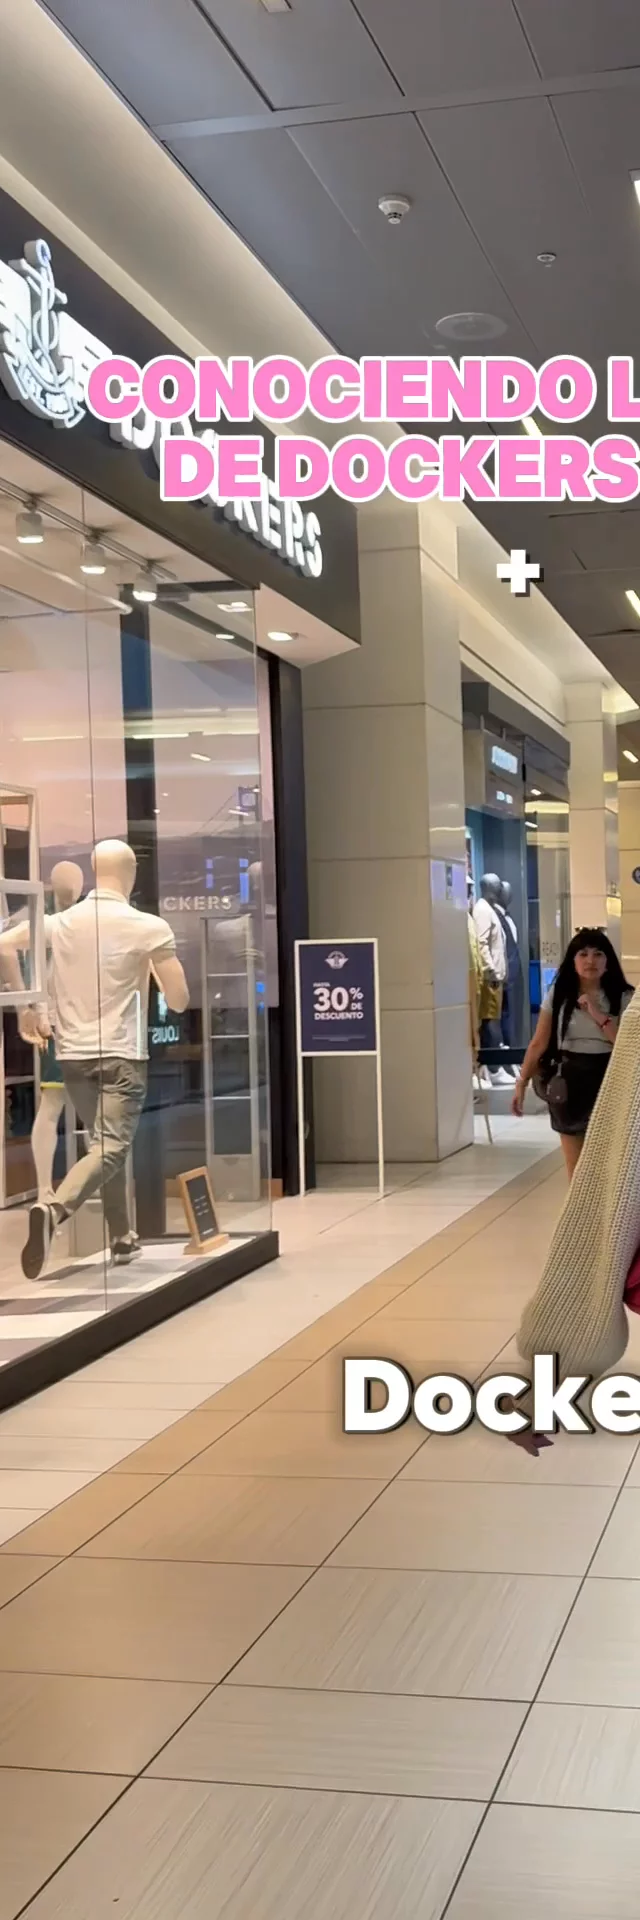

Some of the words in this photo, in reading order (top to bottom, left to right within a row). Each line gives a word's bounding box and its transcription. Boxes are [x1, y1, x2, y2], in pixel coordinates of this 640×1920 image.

[313, 986, 364, 1012] 30%
[351, 1002, 363, 1010] DE
[314, 1011, 364, 1020] DESCUENTO
